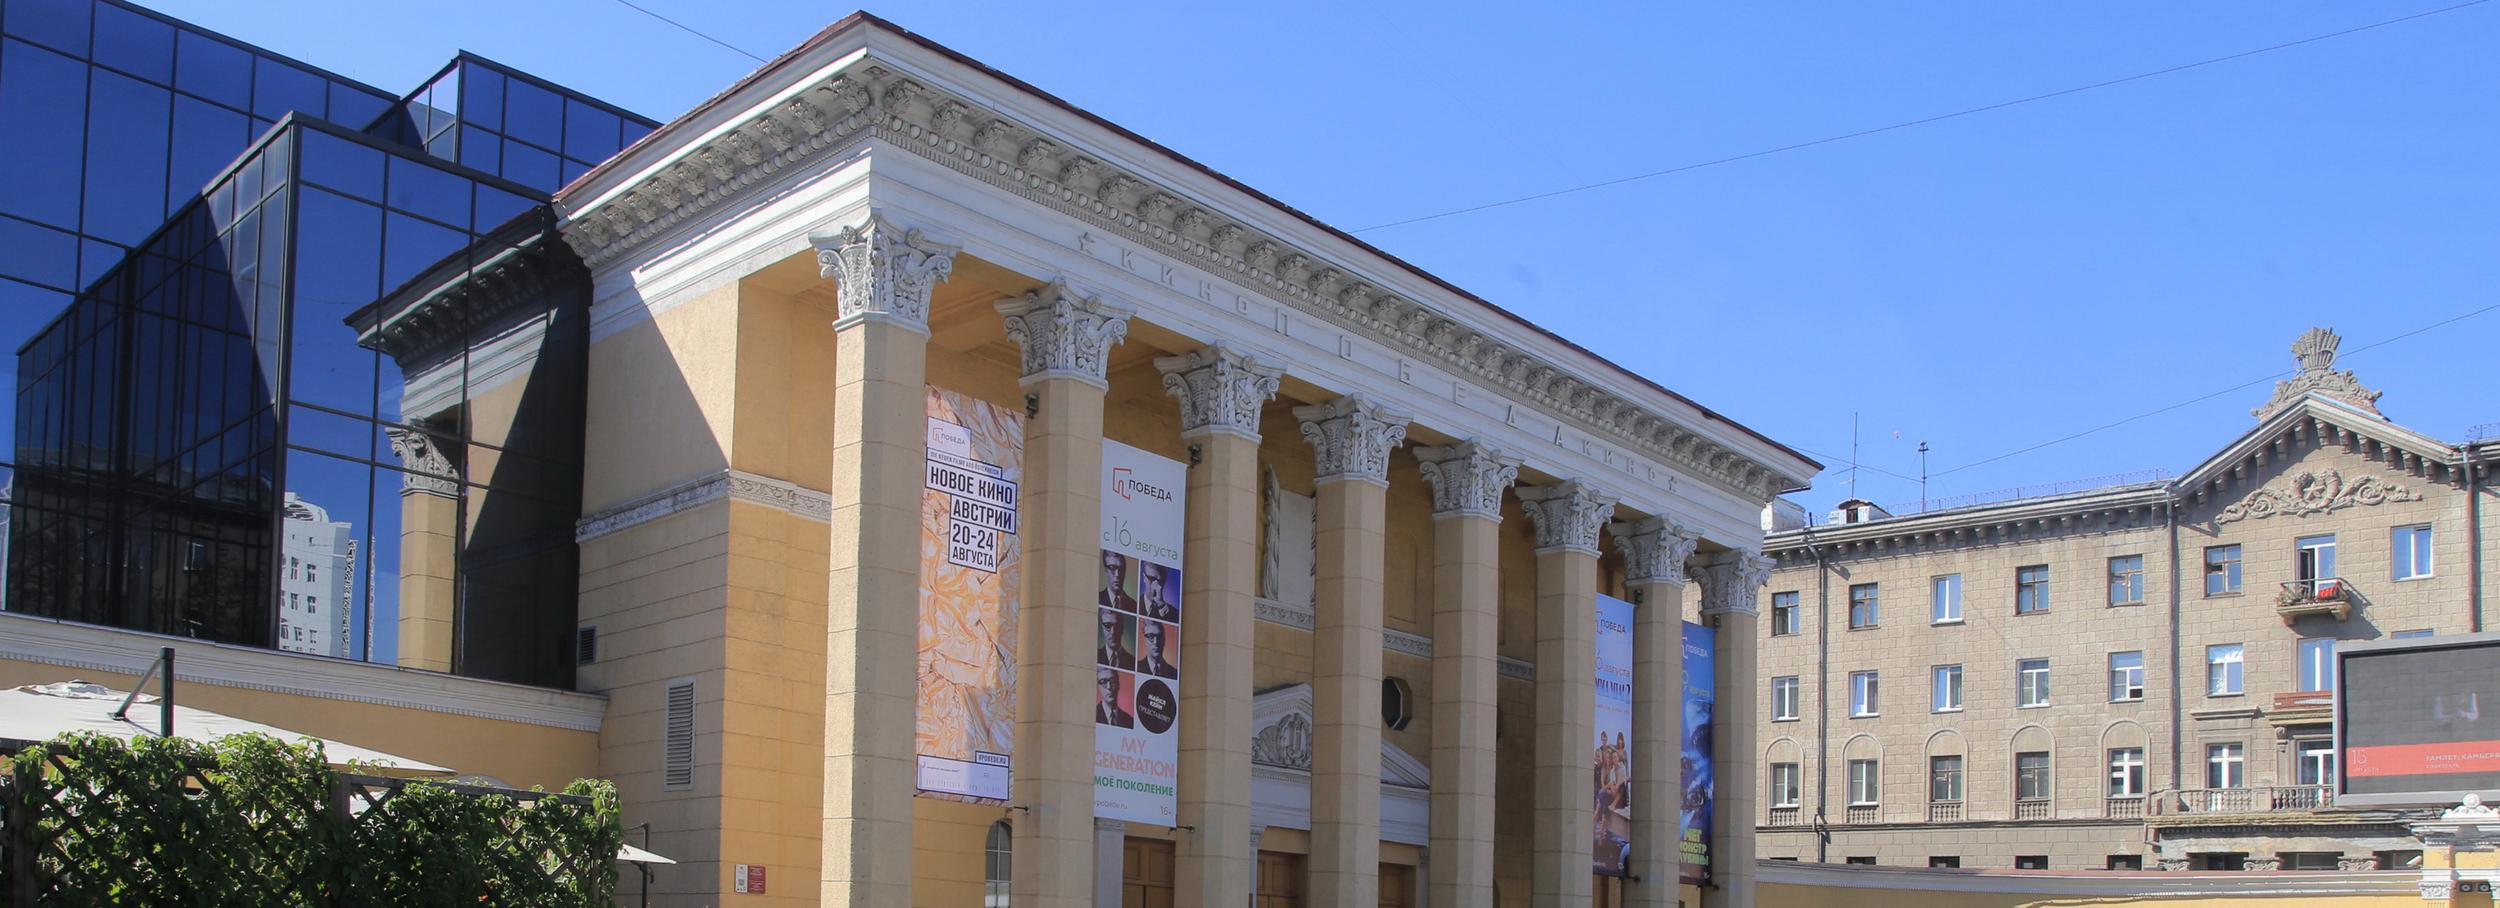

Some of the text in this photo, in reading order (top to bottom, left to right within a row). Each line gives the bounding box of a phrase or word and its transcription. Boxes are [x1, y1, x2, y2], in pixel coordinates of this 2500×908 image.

[1121, 248, 1657, 482] КИНО ПОБЕДА КИНО
[941, 433, 966, 445] ПОБЕДА
[930, 466, 1013, 505] НОВОЕ КИНО
[1128, 479, 1173, 502] ПОБЕДА
[953, 499, 1012, 530] АВСТРИИ
[952, 523, 994, 551] 20-24
[1112, 515, 1132, 547] 16
[1135, 540, 1178, 561] августа
[952, 546, 994, 568] АВГУСТА
[1601, 620, 1626, 634] ПОБЕДА
[1120, 736, 1147, 755] MY
[2352, 749, 2368, 765] 15
[1116, 778, 1174, 797] ПОКОЛЕНИЕ
